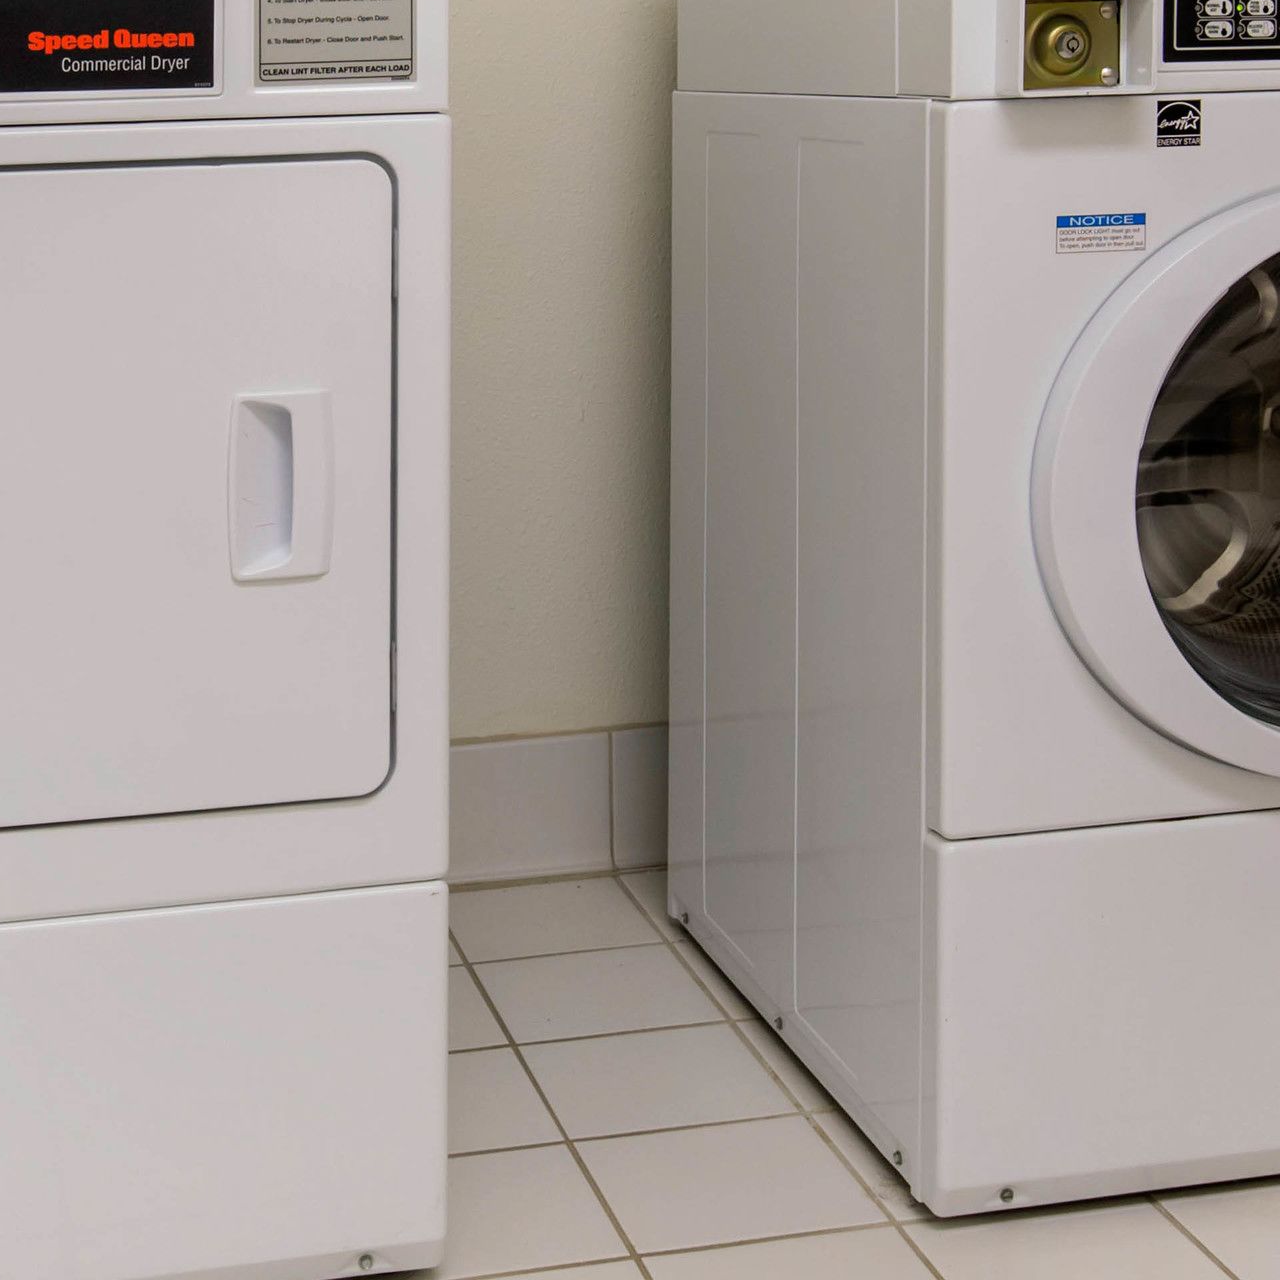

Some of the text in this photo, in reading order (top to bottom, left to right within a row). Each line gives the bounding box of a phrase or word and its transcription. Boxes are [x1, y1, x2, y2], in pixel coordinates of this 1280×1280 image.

[27, 29, 195, 55] Speed Queen
[61, 55, 190, 73] Commercial Dryer
[263, 68, 289, 76] CLEAN
[310, 67, 336, 75] FILTER
[338, 66, 364, 74] AFTER
[365, 65, 386, 73] EACH
[388, 64, 410, 72] LOAD
[1157, 137, 1201, 146] ENERGY STAR
[1069, 215, 1134, 226] NOTICE
